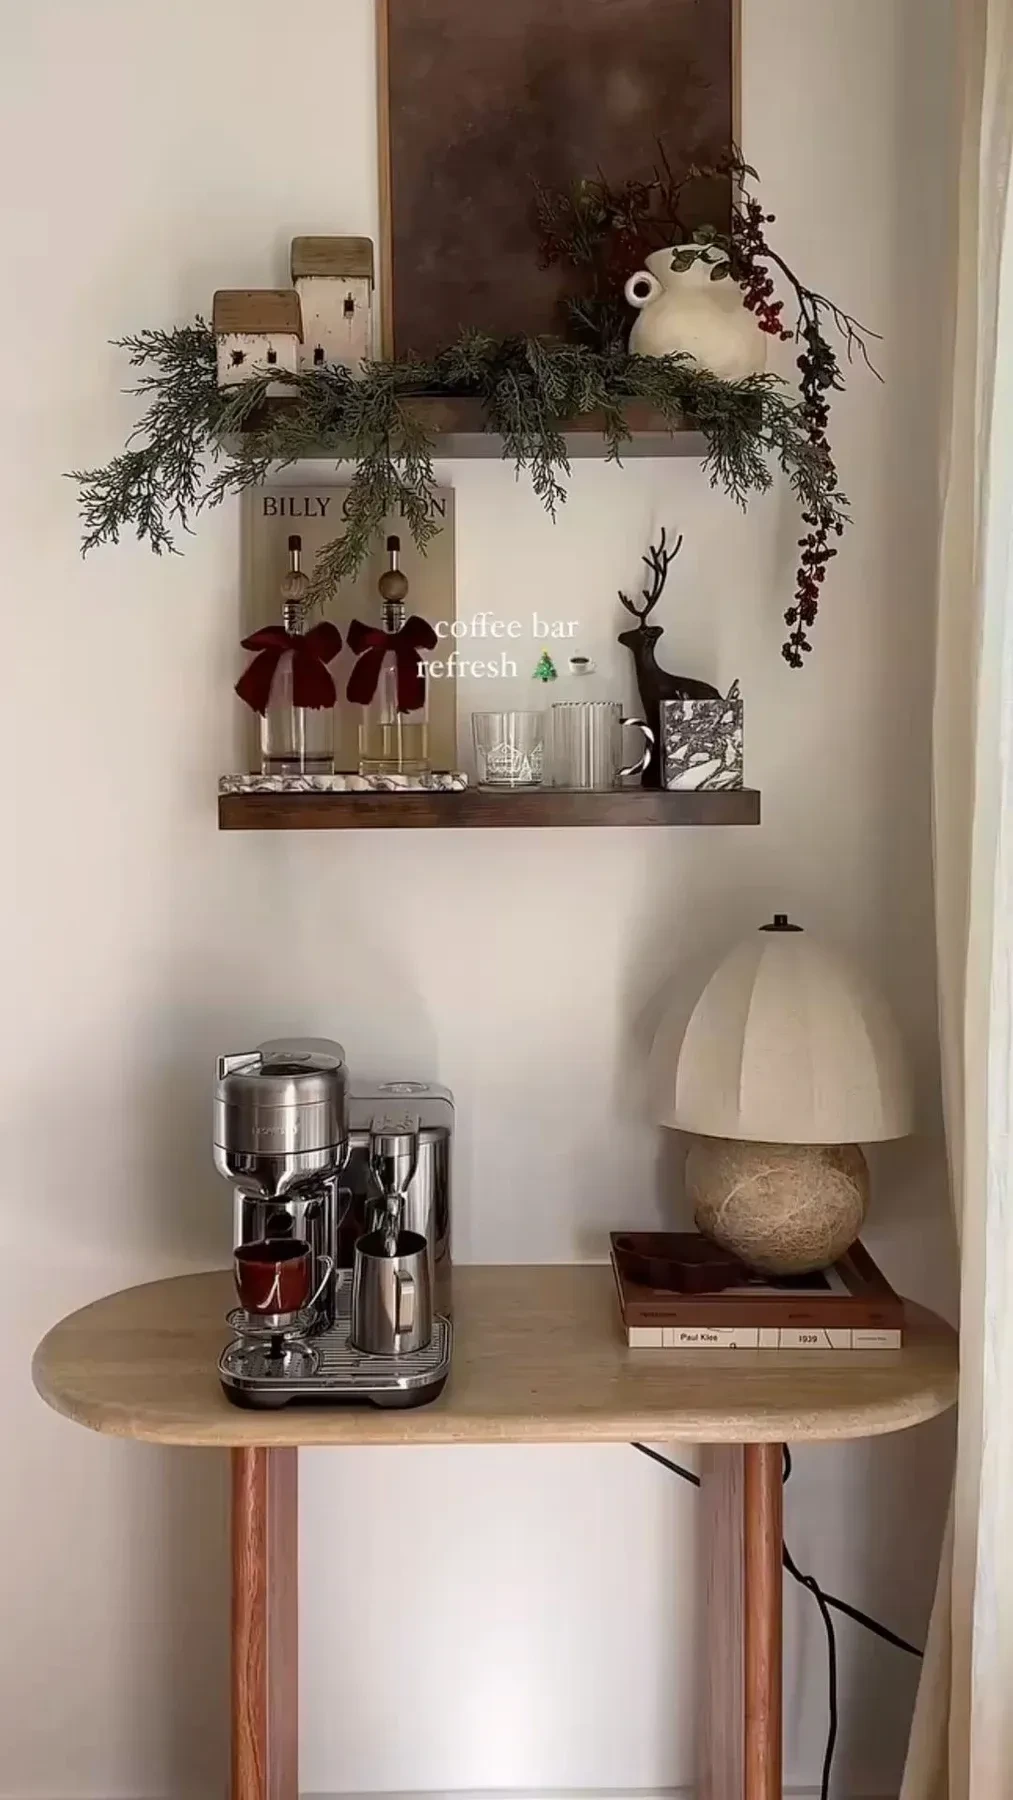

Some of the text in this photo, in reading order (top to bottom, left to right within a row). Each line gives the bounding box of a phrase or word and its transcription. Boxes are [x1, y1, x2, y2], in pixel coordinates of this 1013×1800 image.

[263, 497, 446, 517] BILLY CTTON
[680, 1333, 699, 1341] Paul
